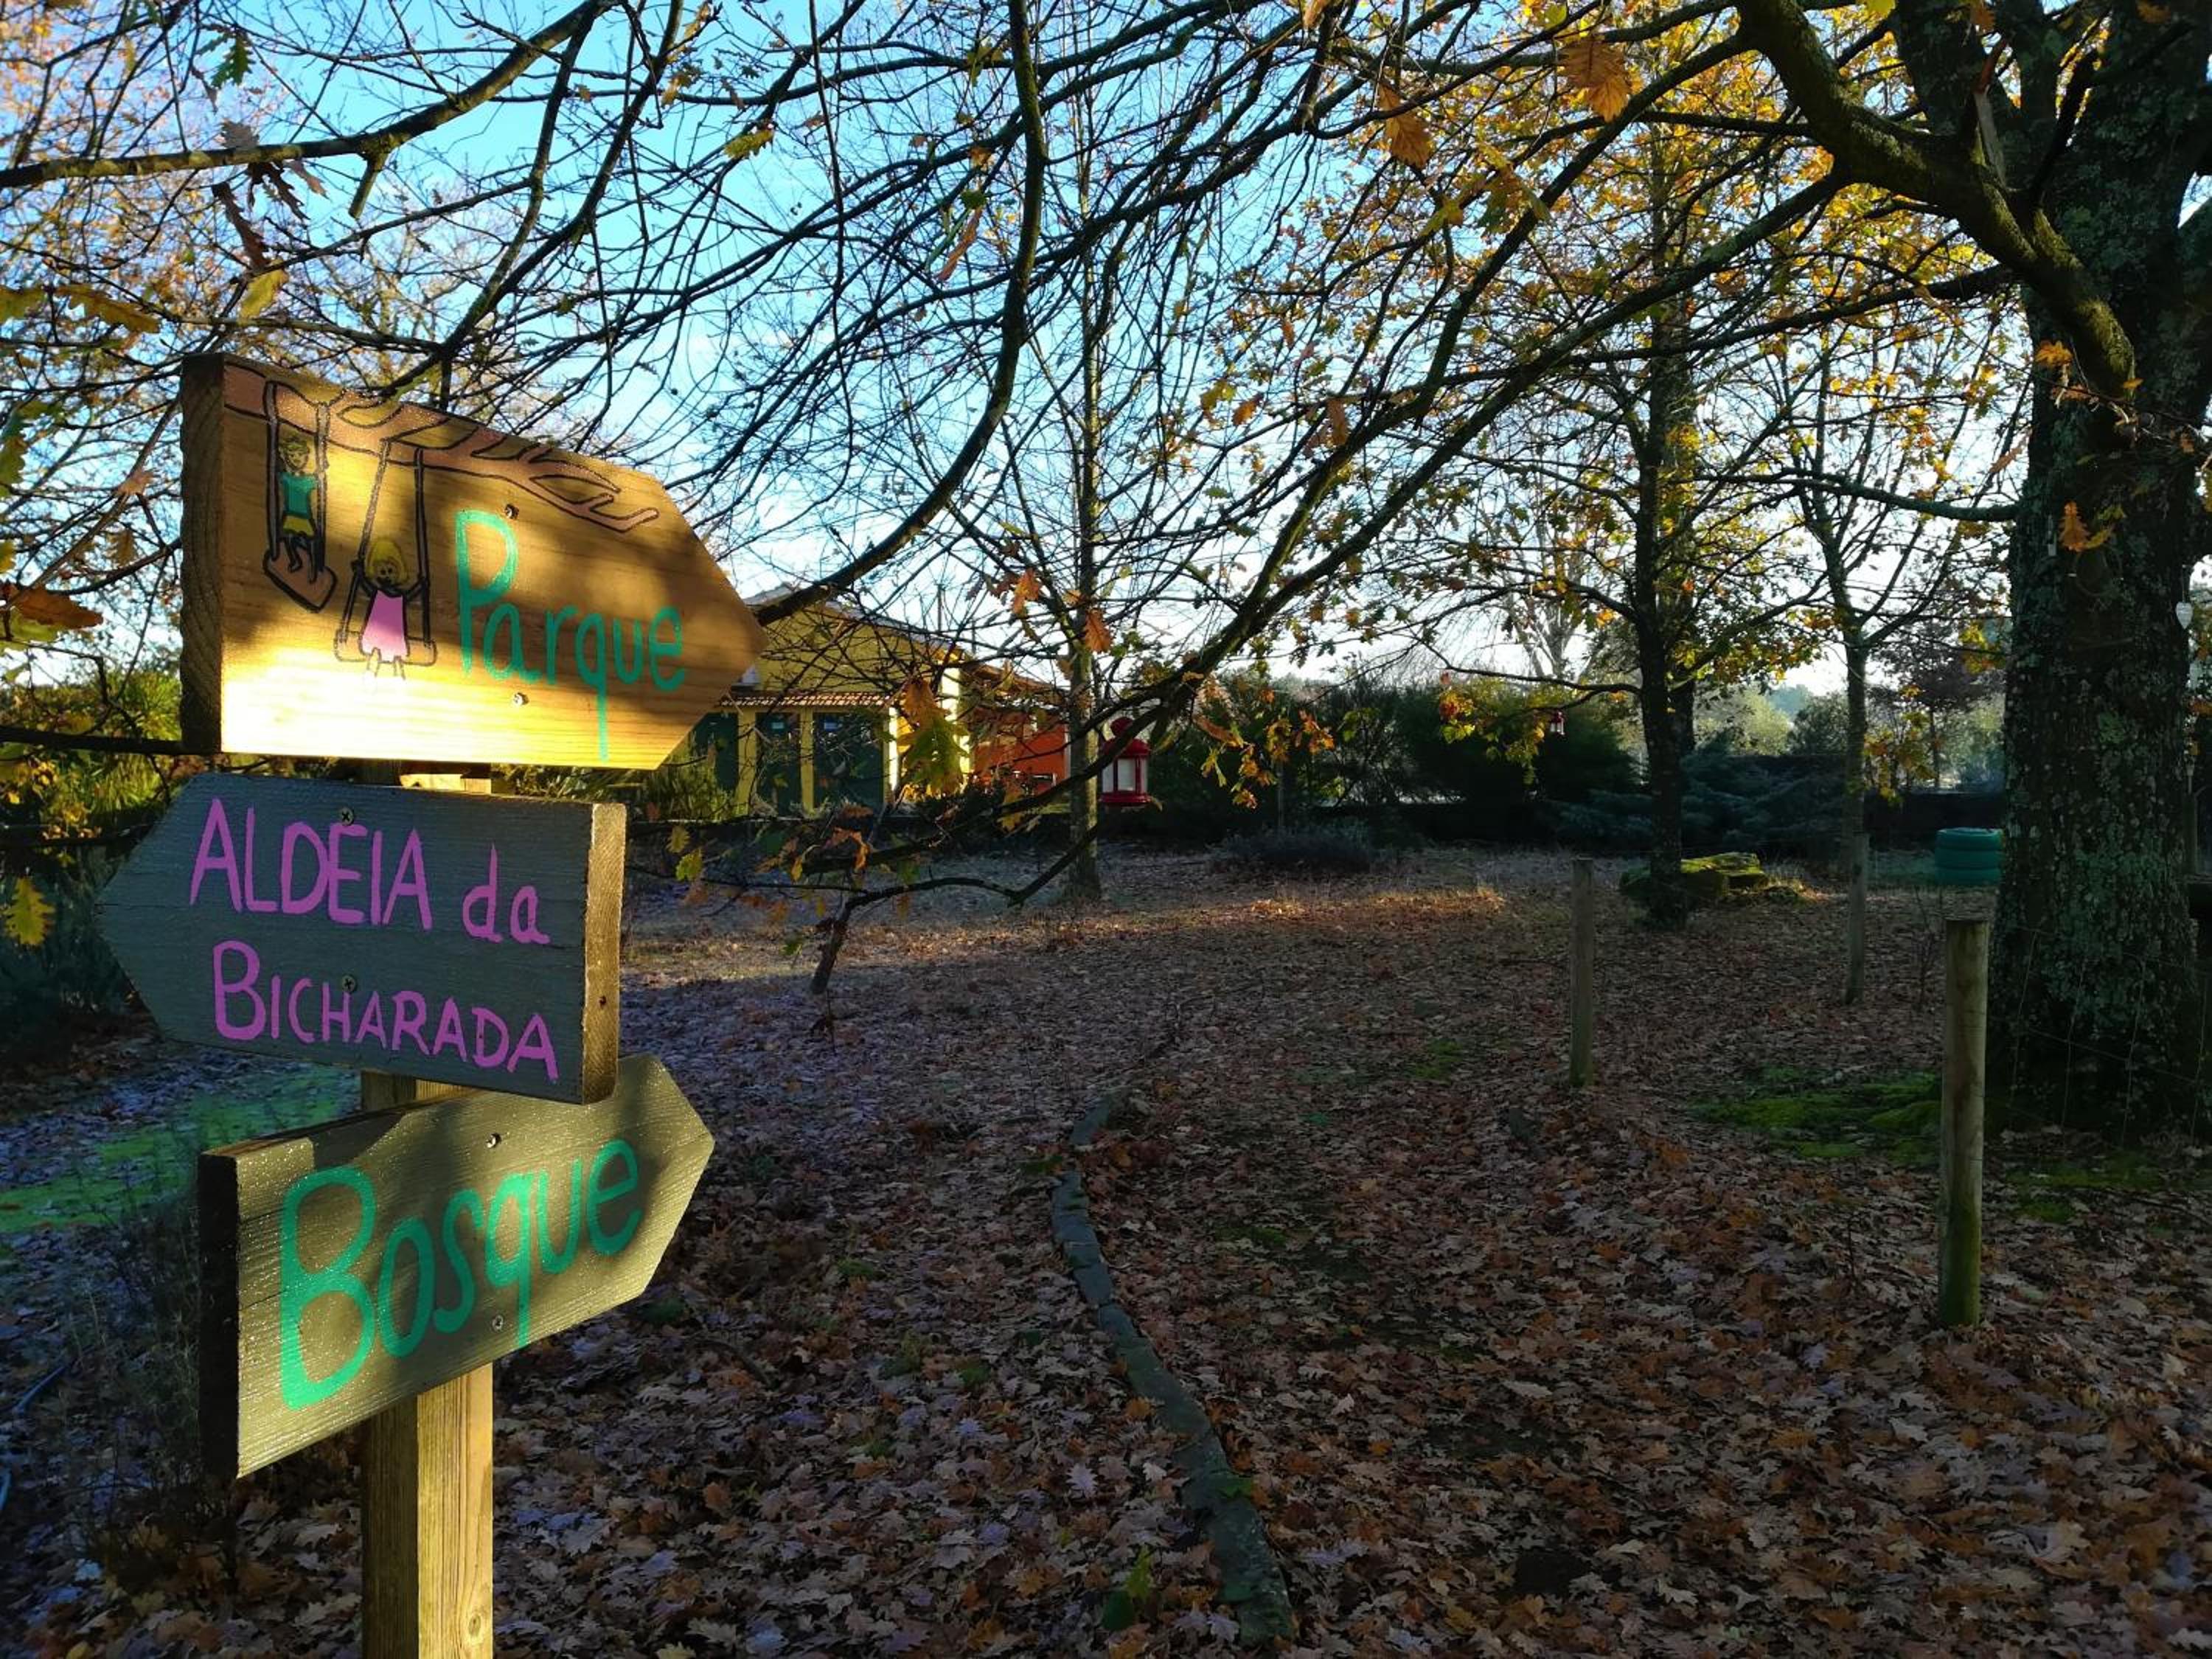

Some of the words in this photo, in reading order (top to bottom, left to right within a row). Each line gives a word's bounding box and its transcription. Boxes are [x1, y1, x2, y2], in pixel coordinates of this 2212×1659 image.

[454, 509, 686, 762] Parque
[189, 799, 432, 930] ALDEIA
[462, 844, 550, 943] da
[213, 940, 558, 1082] BICHARADA
[280, 1138, 642, 1411] Bosque
